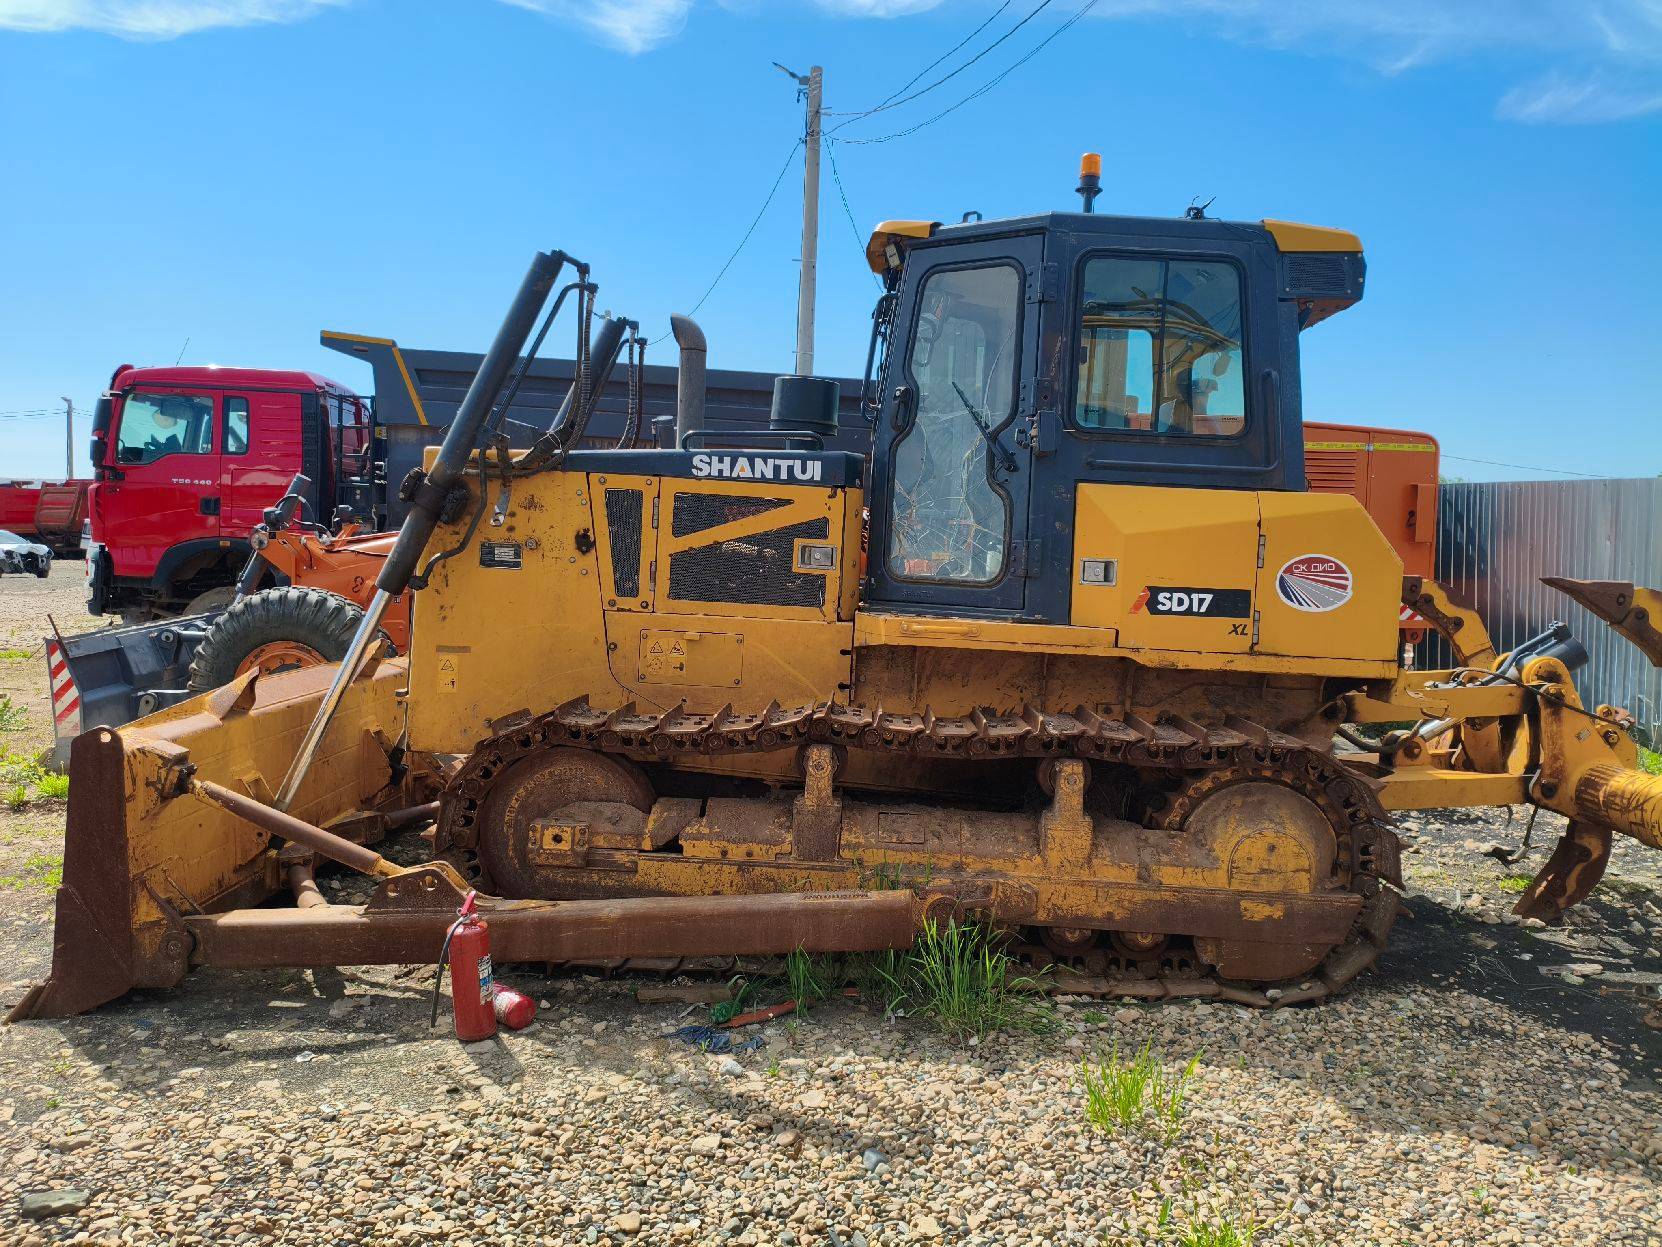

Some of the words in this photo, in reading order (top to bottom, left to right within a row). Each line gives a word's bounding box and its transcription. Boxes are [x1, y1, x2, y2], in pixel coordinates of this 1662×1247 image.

[691, 454, 822, 481] SHANTUI
[1156, 592, 1214, 613] SD17
[1228, 623, 1249, 636] XL
